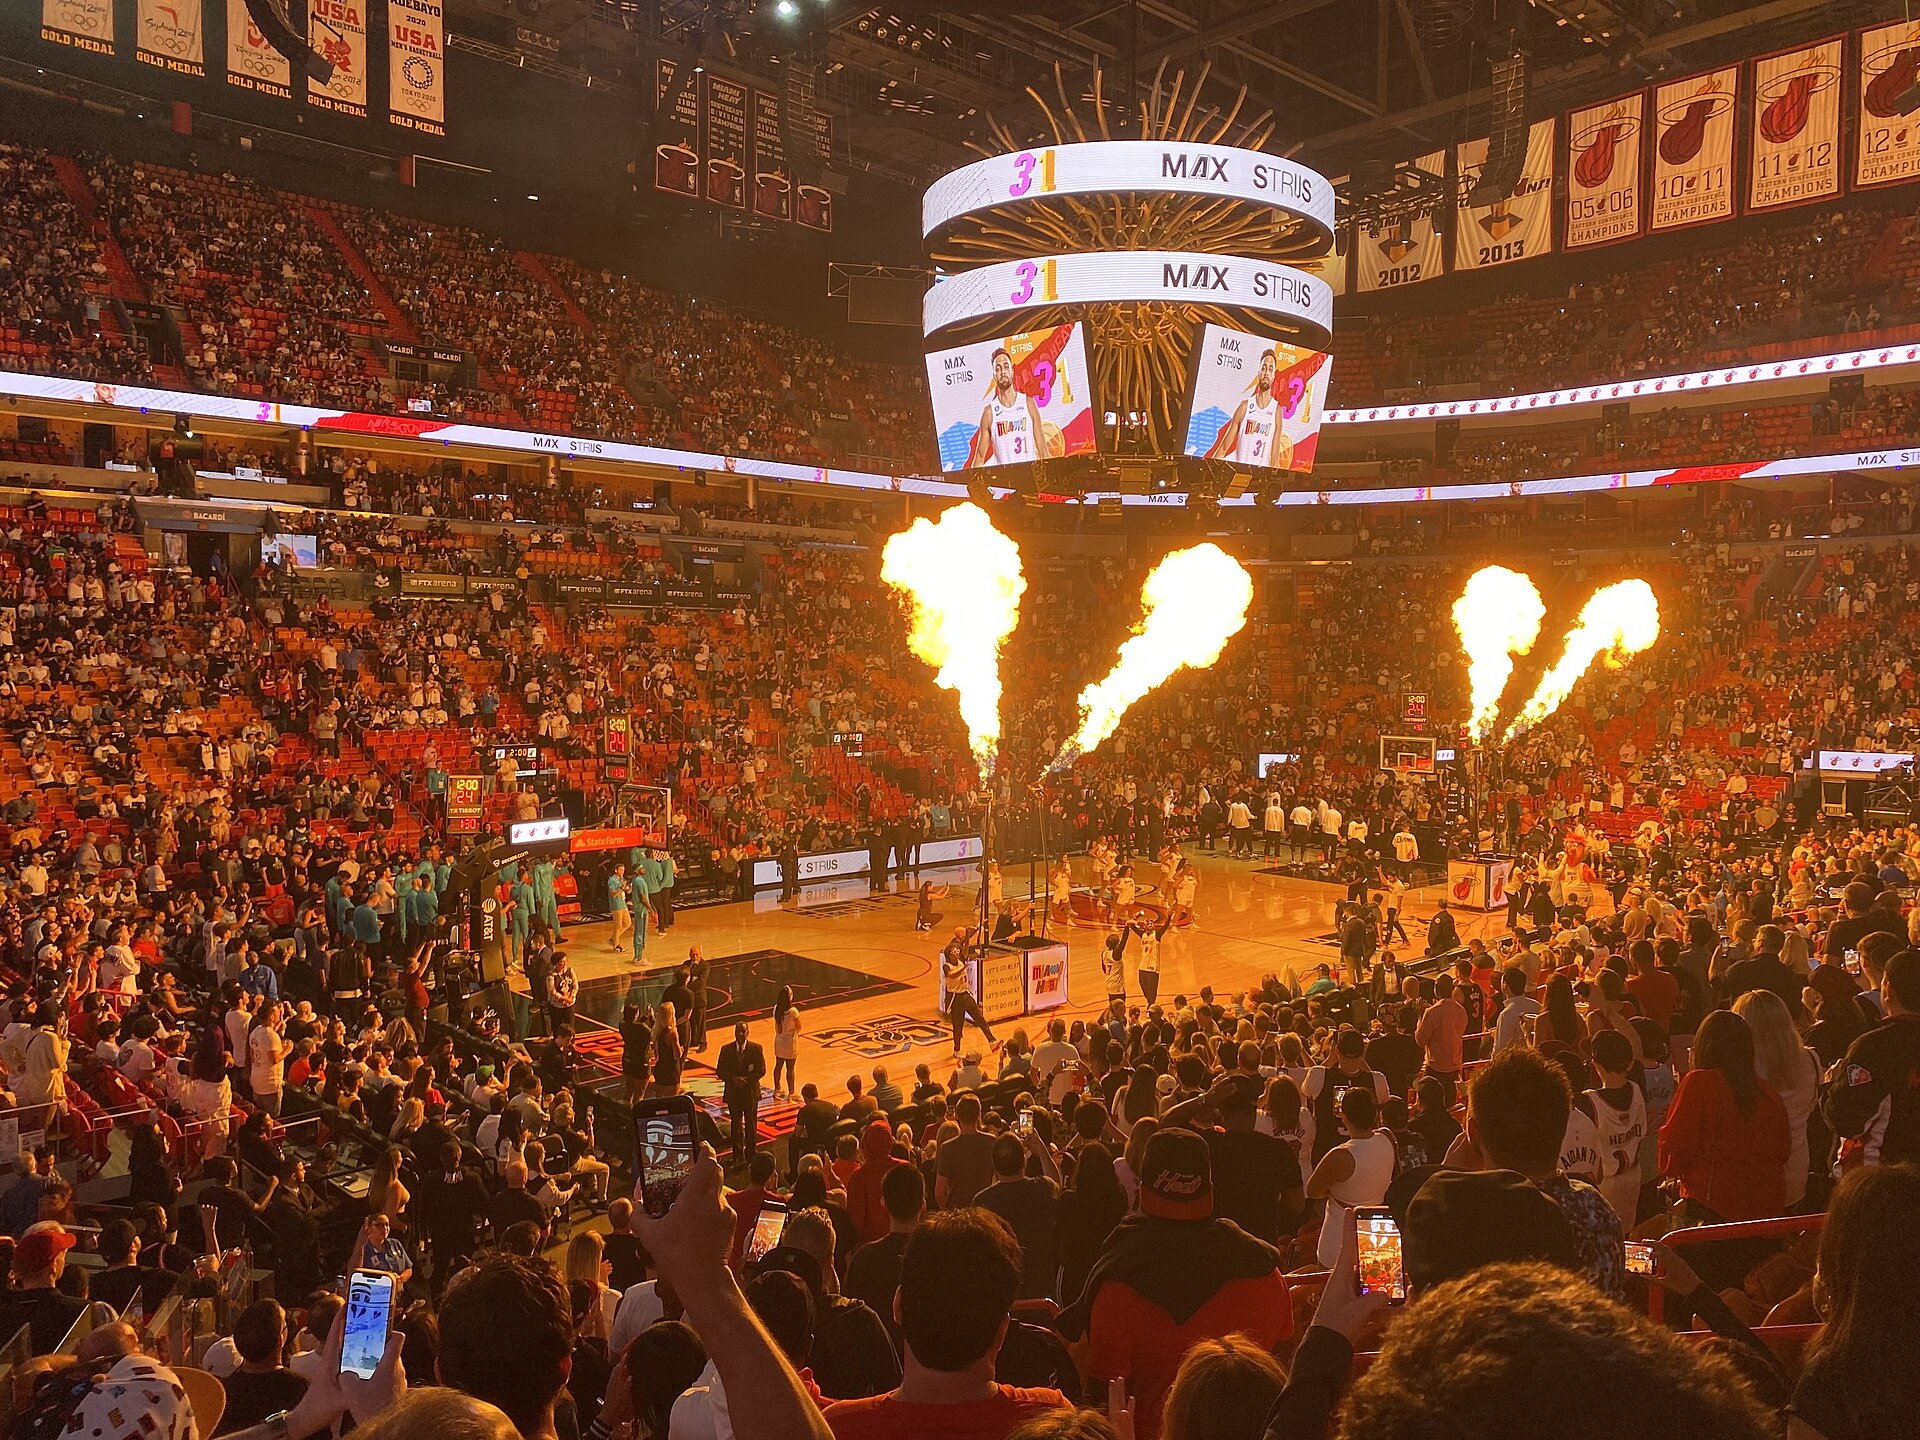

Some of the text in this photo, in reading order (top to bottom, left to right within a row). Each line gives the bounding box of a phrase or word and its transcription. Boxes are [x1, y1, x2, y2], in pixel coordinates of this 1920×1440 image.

[316, 0, 360, 25] USA
[406, 15, 426, 27] 2020
[41, 28, 115, 56] GOLD MEDAL
[395, 25, 436, 51] USA
[409, 43, 442, 60] BASKETBALL
[136, 51, 205, 77] GOLD MEDAL
[227, 73, 292, 99] GOLD MEDAL
[401, 87, 436, 102] TOKYO 2020
[712, 82, 740, 97] MIAMI
[308, 94, 367, 118] GOLD MEDAL
[717, 92, 742, 105] HEAT
[390, 114, 445, 136] GOLD MEDAL
[1864, 128, 1890, 155] 12
[1759, 142, 1831, 179] 11 12
[1863, 154, 1894, 166] EASTERN
[1009, 149, 1312, 203] 31 MAX STRUS
[1660, 167, 1724, 200] 10 11
[1756, 177, 1786, 189] EASTERN
[1756, 178, 1832, 203] CHAMPIONS
[1571, 188, 1633, 220] 05 06
[1656, 200, 1726, 223] CHAMPIONS
[1571, 220, 1634, 242] CHAMPIONS
[1478, 240, 1525, 265] 2013
[1010, 259, 1312, 308] 31 MAX STRUS
[1378, 264, 1421, 287] 2012
[1220, 336, 1241, 353] MAX
[433, 351, 462, 362] BACARDÍ
[944, 355, 966, 370] MAX
[1216, 353, 1243, 370] STRUS
[945, 370, 974, 385] STRUS
[1033, 357, 1074, 408] 31
[1282, 377, 1315, 423] 31
[256, 401, 281, 423] 31
[533, 437, 559, 449] MAX
[569, 441, 602, 454] STRUS
[1014, 436, 1028, 454] 31
[1253, 439, 1267, 458] 31
[1857, 454, 1888, 466] MAX
[1149, 495, 1169, 503] MAX
[193, 512, 226, 521] BACARDÍ
[1407, 703, 1424, 716] 24
[1408, 695, 1426, 704] 12:00
[610, 718, 626, 732] 12:00
[609, 731, 625, 752] 24
[456, 779, 479, 790] 12:00
[456, 790, 474, 803] 24
[958, 839, 974, 857] 31
[806, 859, 838, 873] STRUS
[483, 914, 494, 942] AT&T
[1561, 1146, 1587, 1170] AIDAN
[1153, 1169, 1202, 1194] Heat
